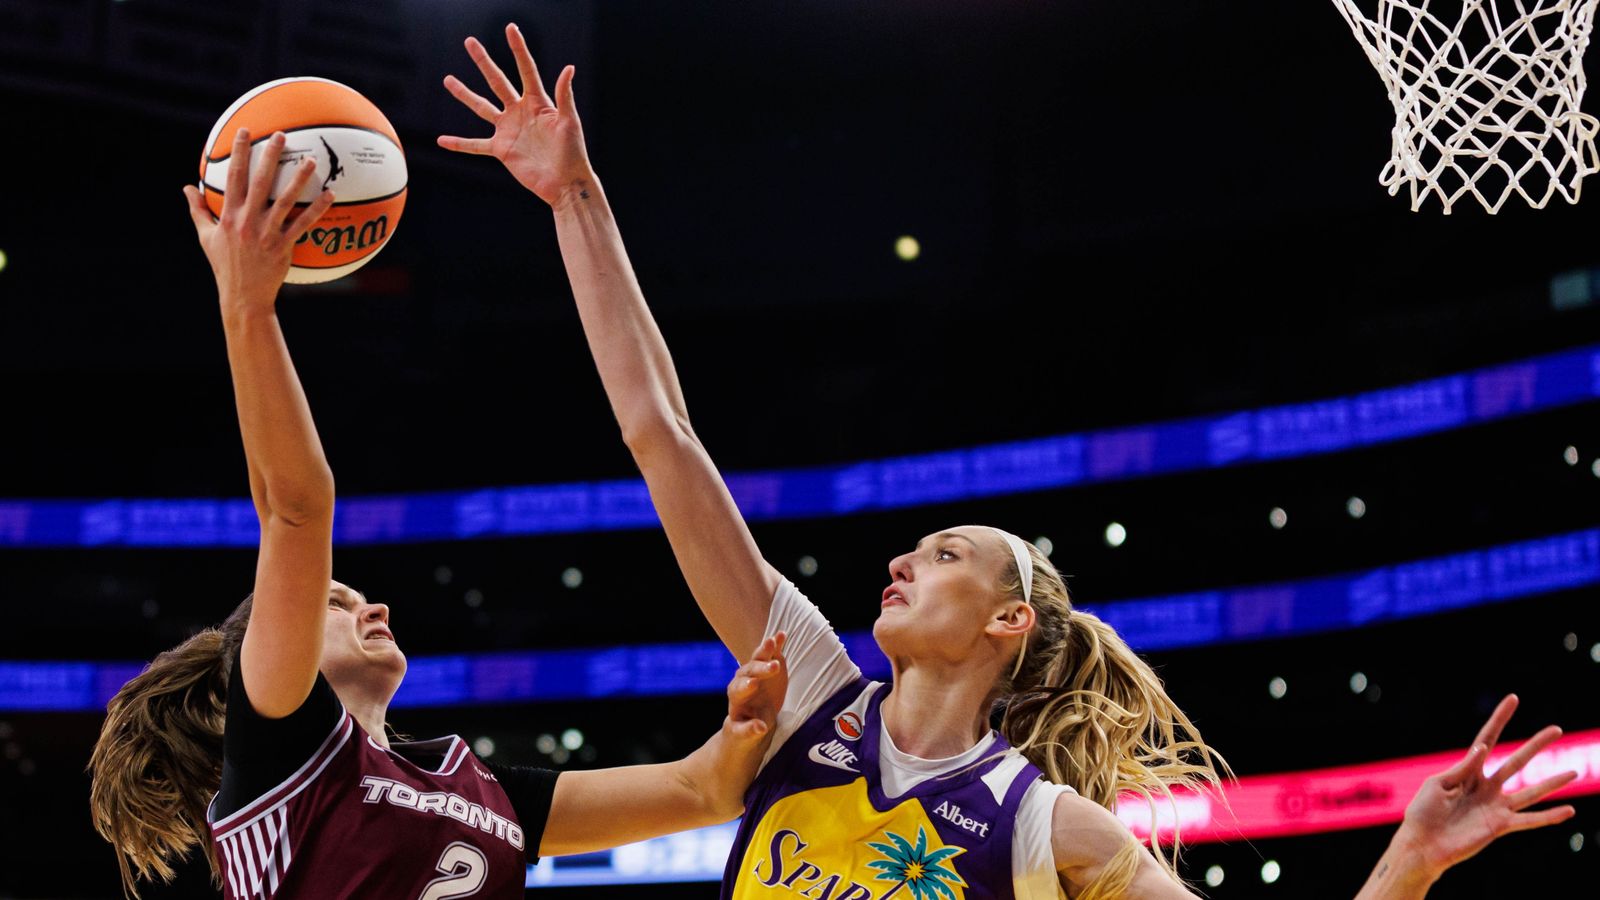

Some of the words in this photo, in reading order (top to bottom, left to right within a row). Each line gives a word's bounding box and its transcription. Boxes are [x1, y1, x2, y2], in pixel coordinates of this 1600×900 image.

[294, 215, 388, 255] Wils
[820, 739, 859, 765] NIKE
[360, 775, 525, 852] TORONTO
[933, 800, 990, 838] Albert
[418, 841, 489, 900] 2
[753, 828, 873, 900] SPAR
